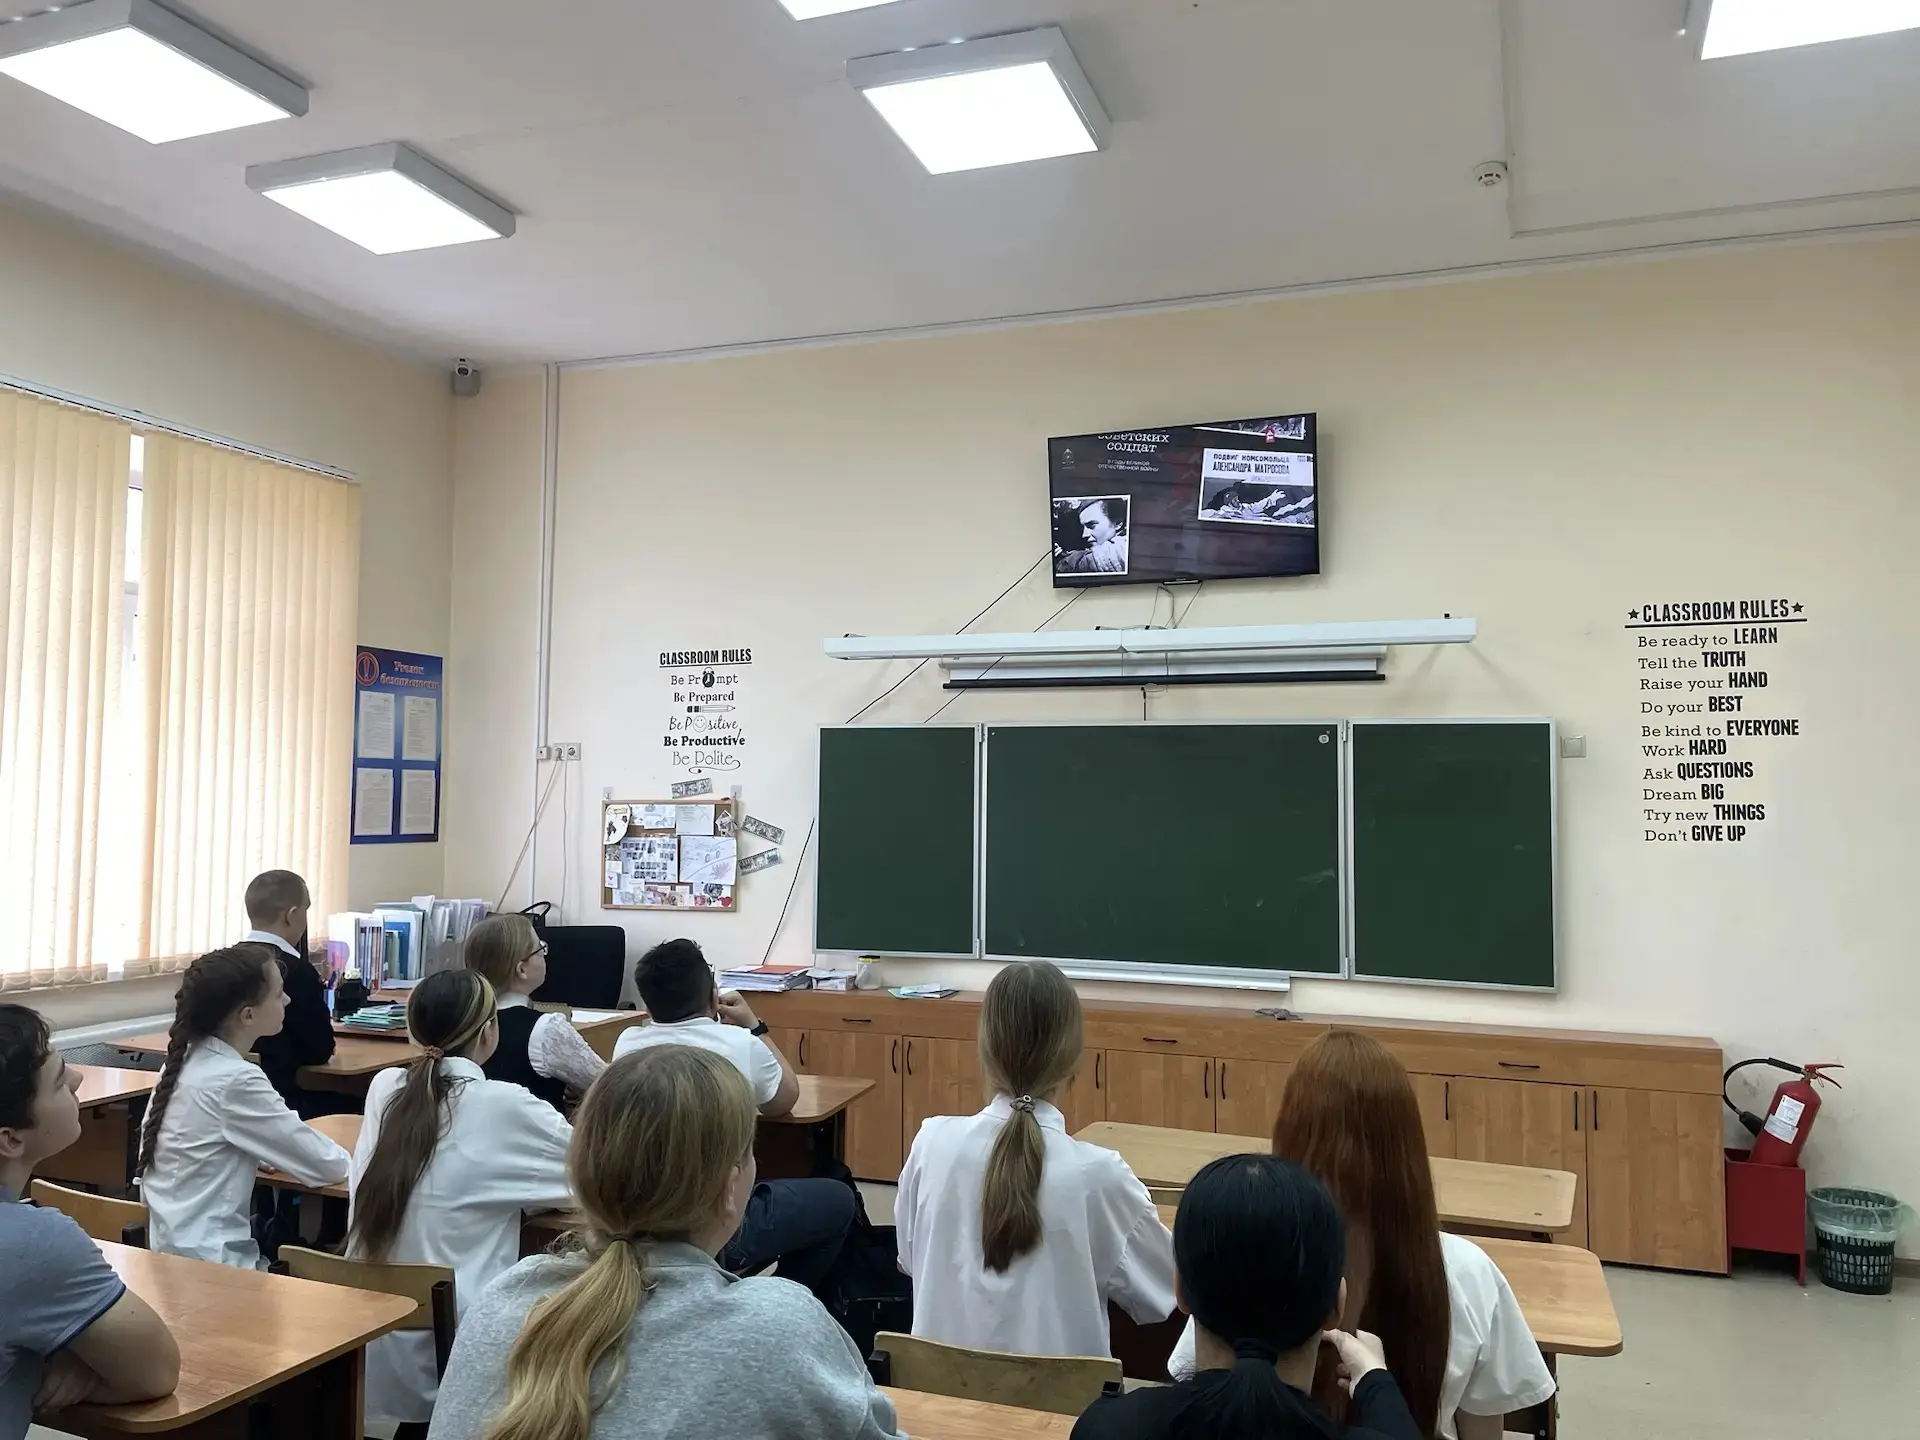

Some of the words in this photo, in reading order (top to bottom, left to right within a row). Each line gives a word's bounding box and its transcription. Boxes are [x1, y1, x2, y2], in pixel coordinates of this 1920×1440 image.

[1106, 442, 1158, 453] солдат
[1642, 601, 1735, 622] CLASSROOM
[1740, 600, 1789, 619] RULES
[1638, 636, 1657, 647] Be
[1662, 635, 1708, 648] ready
[1713, 636, 1728, 646] to
[1734, 627, 1778, 644] LEARN
[660, 650, 719, 665] CLASSROOM
[722, 648, 752, 662] RULES
[1638, 658, 1667, 669] Tell
[1672, 657, 1697, 668] the
[1702, 651, 1745, 667] TRUTH
[671, 675, 684, 685] Be
[1640, 678, 1683, 690] Raise
[1688, 680, 1723, 691] your
[1728, 672, 1768, 688] HAND
[674, 692, 685, 702] Be
[689, 691, 734, 704] Prepared
[1641, 702, 1663, 713] Do
[1667, 704, 1703, 715] your
[1709, 696, 1743, 712] BEST
[669, 716, 683, 730] Be
[1642, 726, 1661, 737] Be
[1665, 725, 1701, 737] kind
[1706, 727, 1721, 736] to
[1727, 719, 1799, 736] EVERYONE
[664, 736, 678, 746] Be
[681, 732, 745, 746] Productive
[1642, 745, 1684, 756] Work
[1689, 739, 1726, 756] HARD
[673, 751, 690, 765] Be
[694, 750, 741, 766] Polite
[1643, 768, 1673, 780] Ask
[1677, 762, 1753, 780] QUESTIONS
[1643, 789, 1697, 800] Dream
[1701, 784, 1724, 800] BIG
[1643, 809, 1671, 823] Try
[1675, 811, 1708, 821] new
[1713, 804, 1765, 820] THINGS
[1645, 829, 1687, 842] Don't
[1692, 825, 1723, 842] GIVE
[1727, 825, 1745, 841] UP
